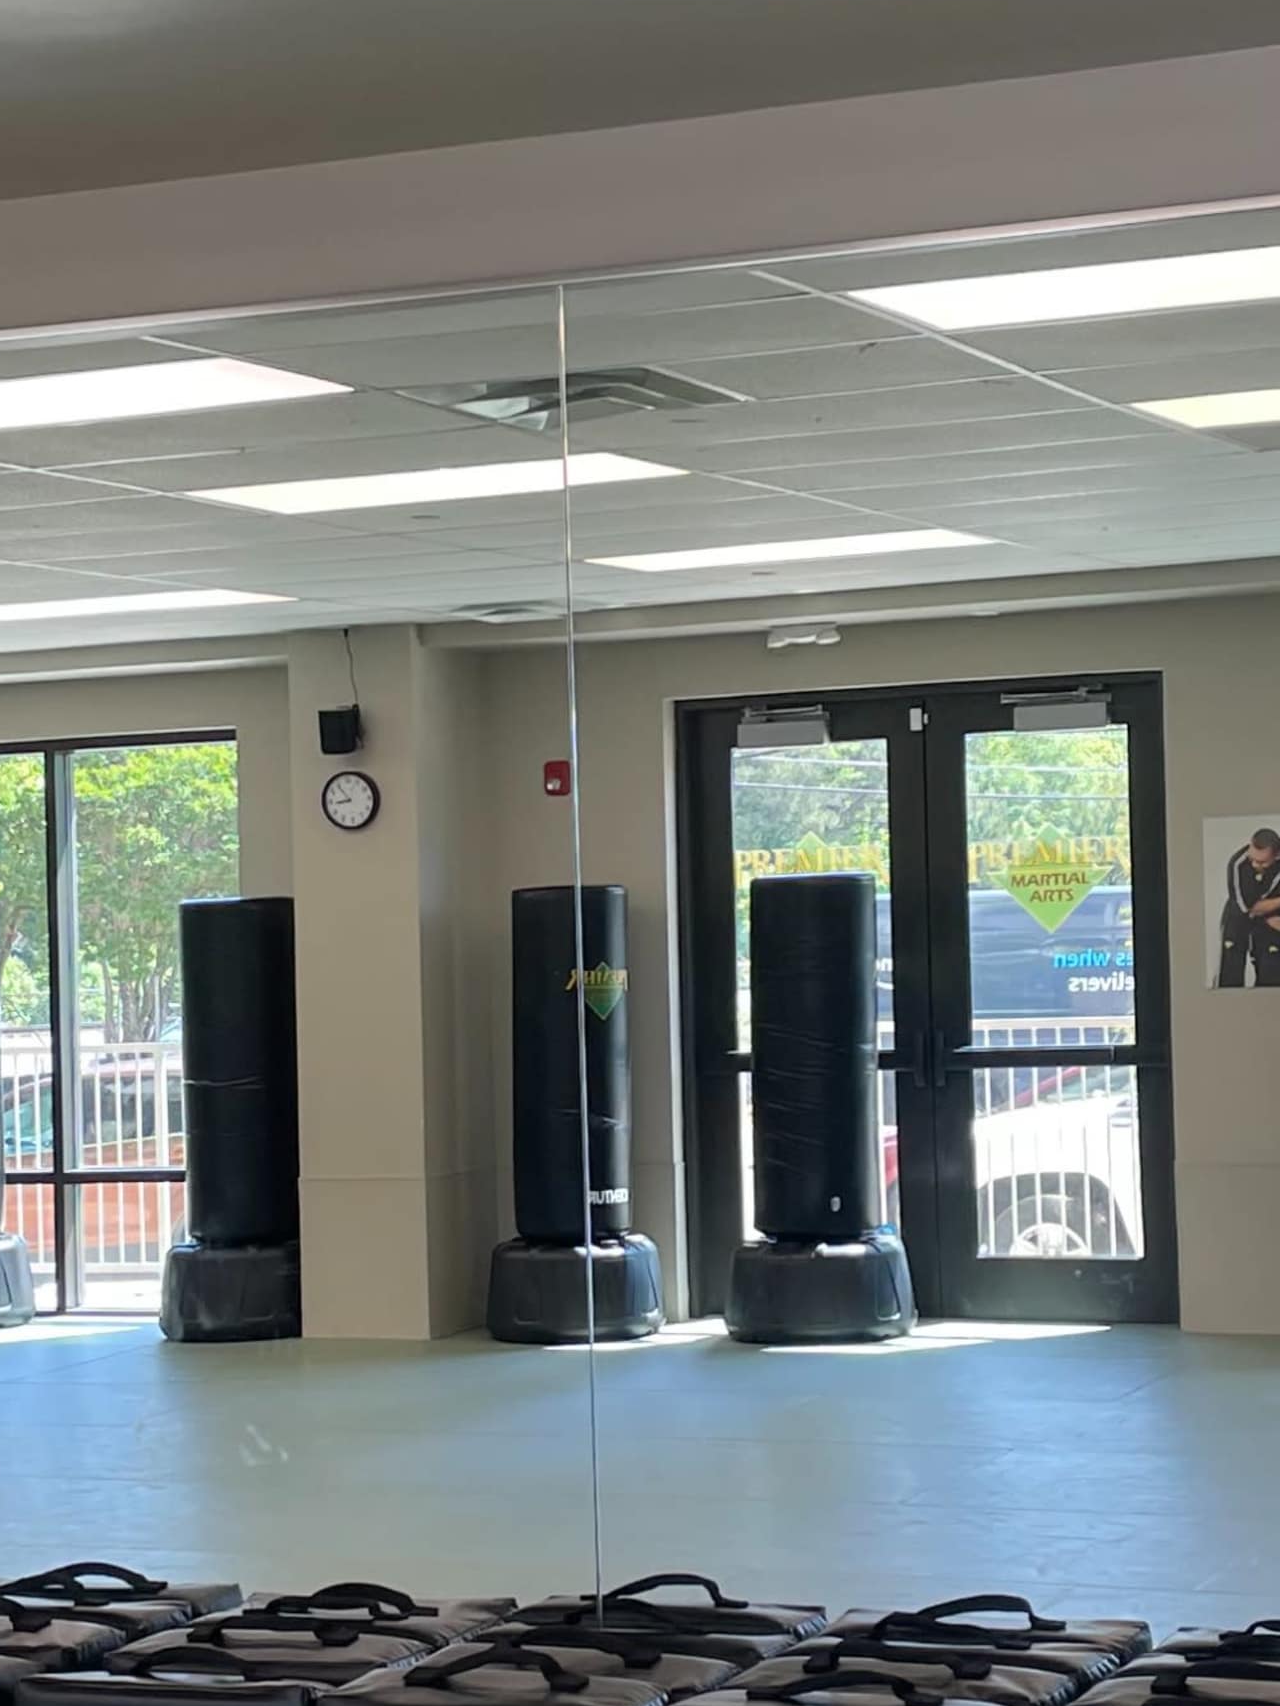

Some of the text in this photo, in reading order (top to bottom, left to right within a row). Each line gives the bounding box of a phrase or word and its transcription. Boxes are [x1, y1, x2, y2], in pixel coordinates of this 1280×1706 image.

[969, 835, 1131, 883] PREMIER
[1010, 870, 1090, 889] MARTIAL
[1029, 888, 1075, 904] ARTS
